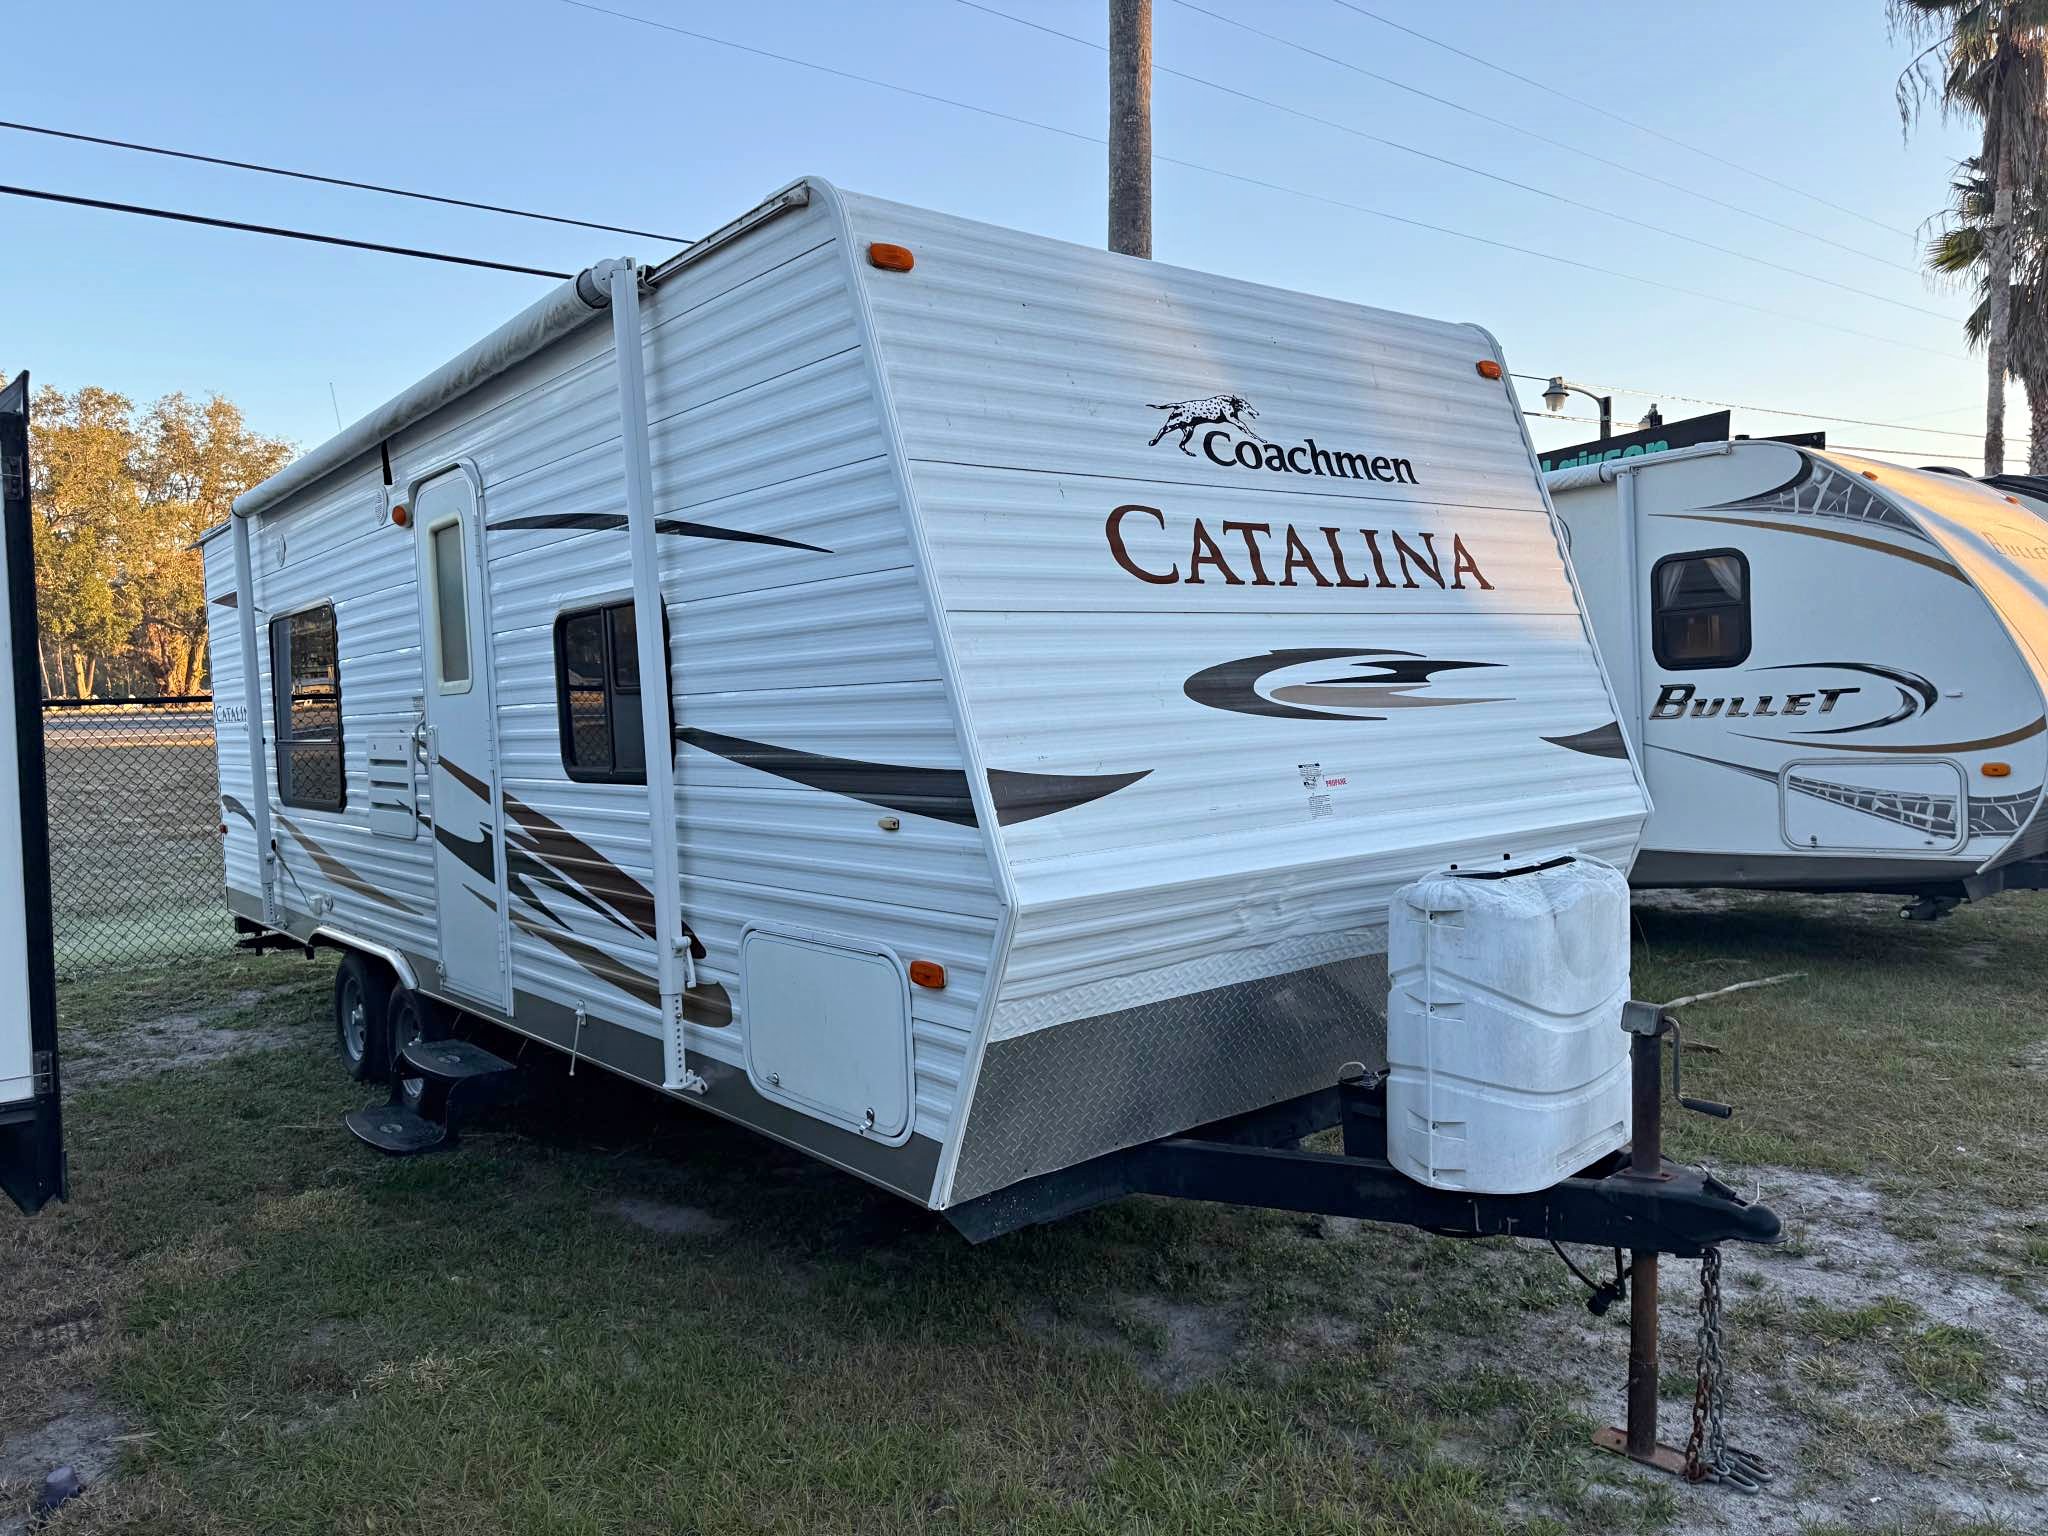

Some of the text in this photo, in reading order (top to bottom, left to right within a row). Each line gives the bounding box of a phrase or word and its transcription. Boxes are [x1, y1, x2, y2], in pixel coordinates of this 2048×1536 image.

[1202, 430, 1420, 485] Coachmen
[1105, 504, 1495, 590] CATALINA
[1649, 683, 1861, 720] BULLET
